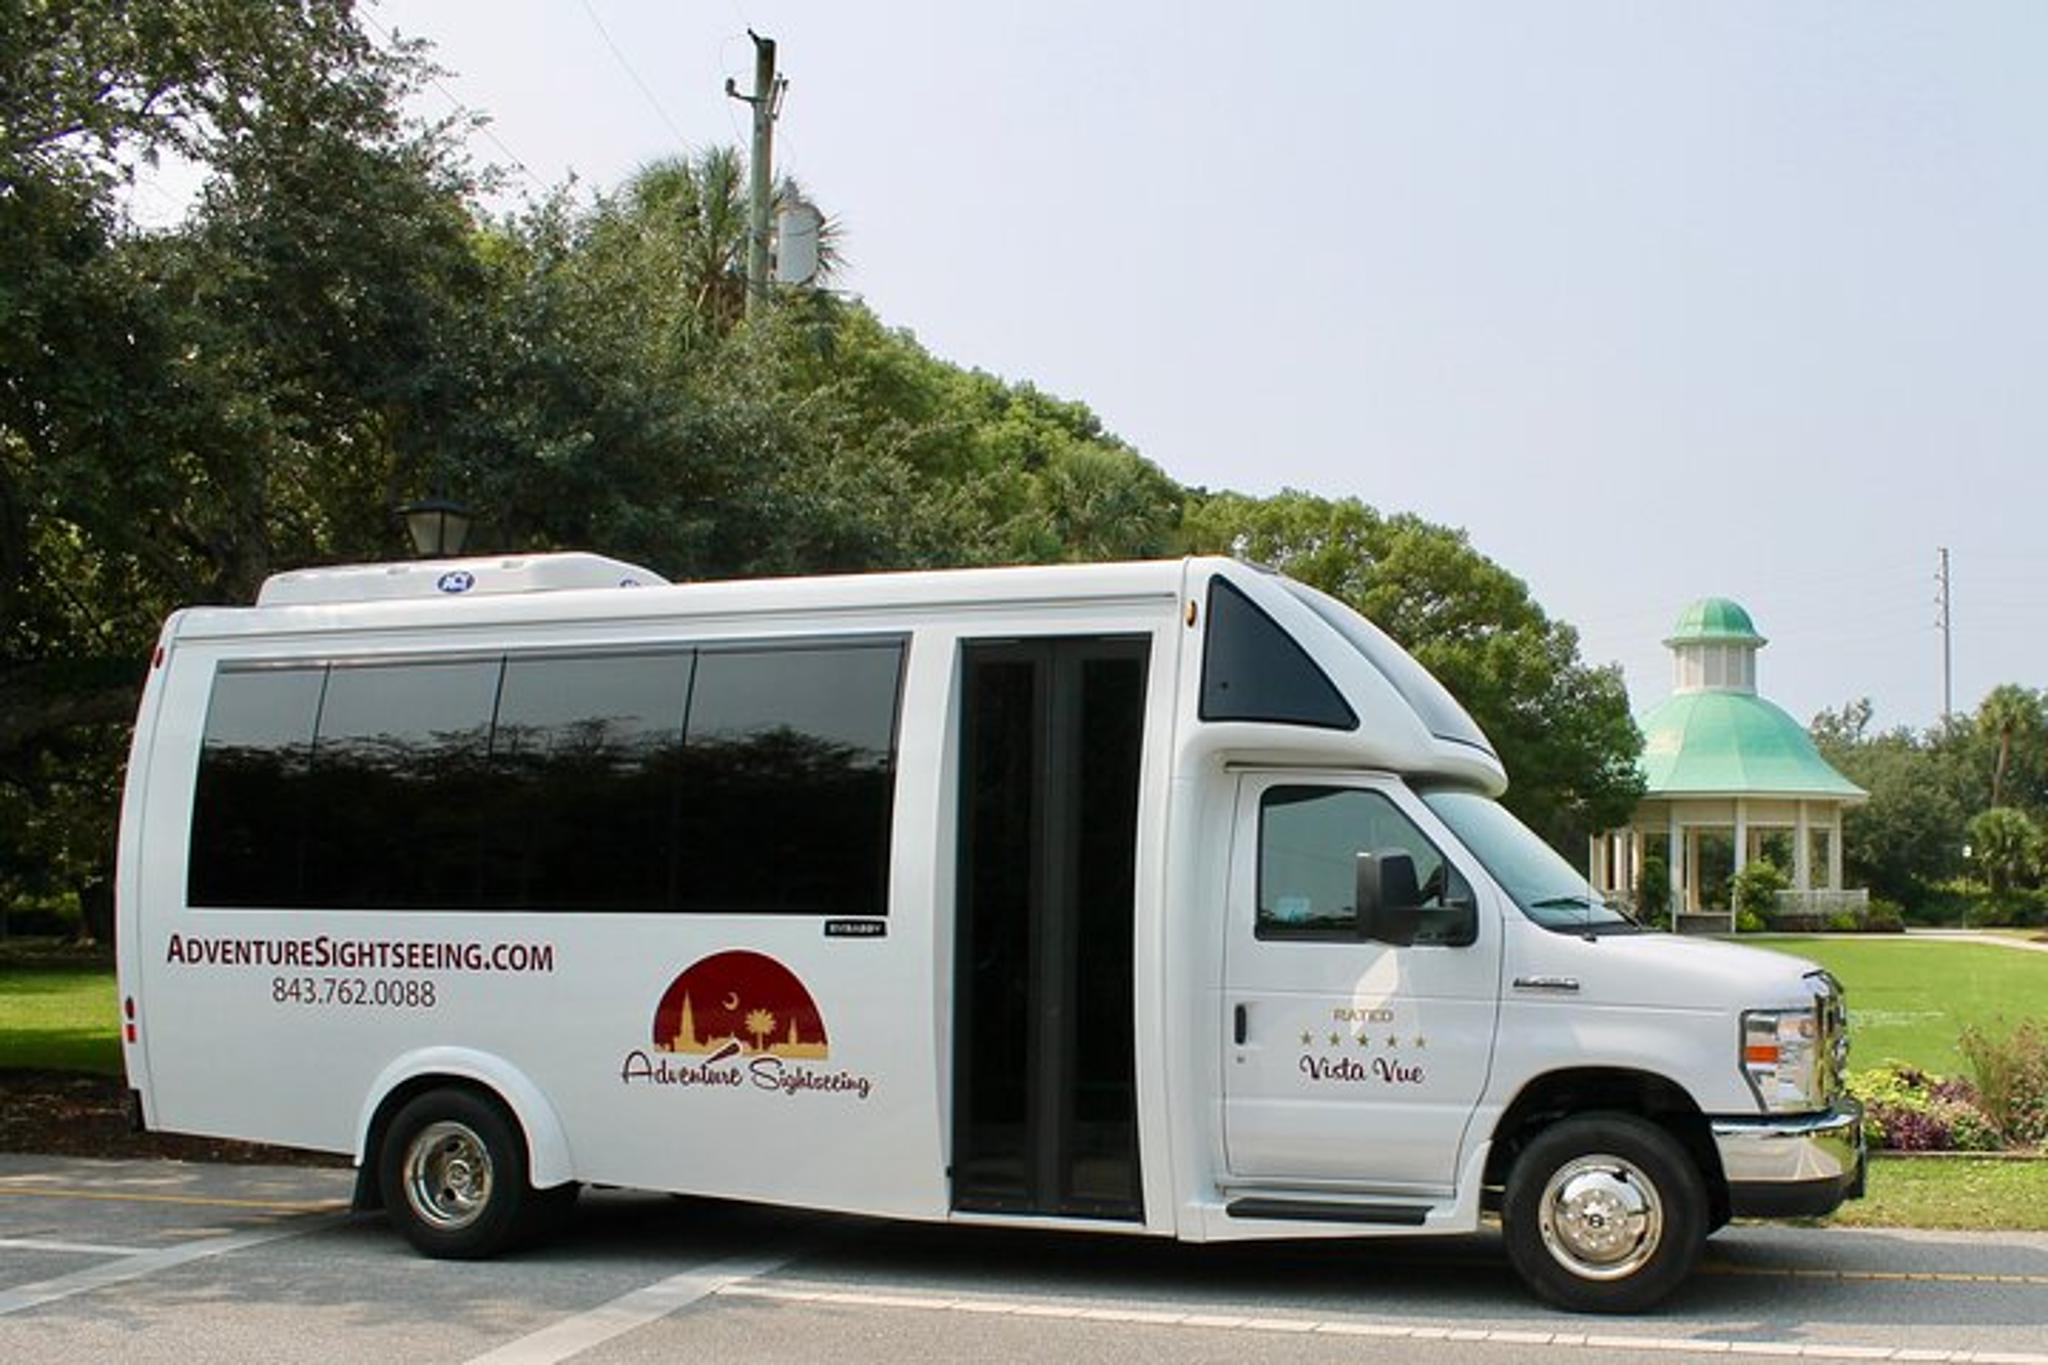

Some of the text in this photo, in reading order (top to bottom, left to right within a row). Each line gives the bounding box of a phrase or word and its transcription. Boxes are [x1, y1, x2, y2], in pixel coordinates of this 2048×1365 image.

[272, 977, 436, 1007] 843.762.0088
[1333, 1008, 1394, 1022] RATED
[622, 1042, 871, 1099] Adventure Sightseeing
[1300, 1054, 1426, 1084] Vista Vue
